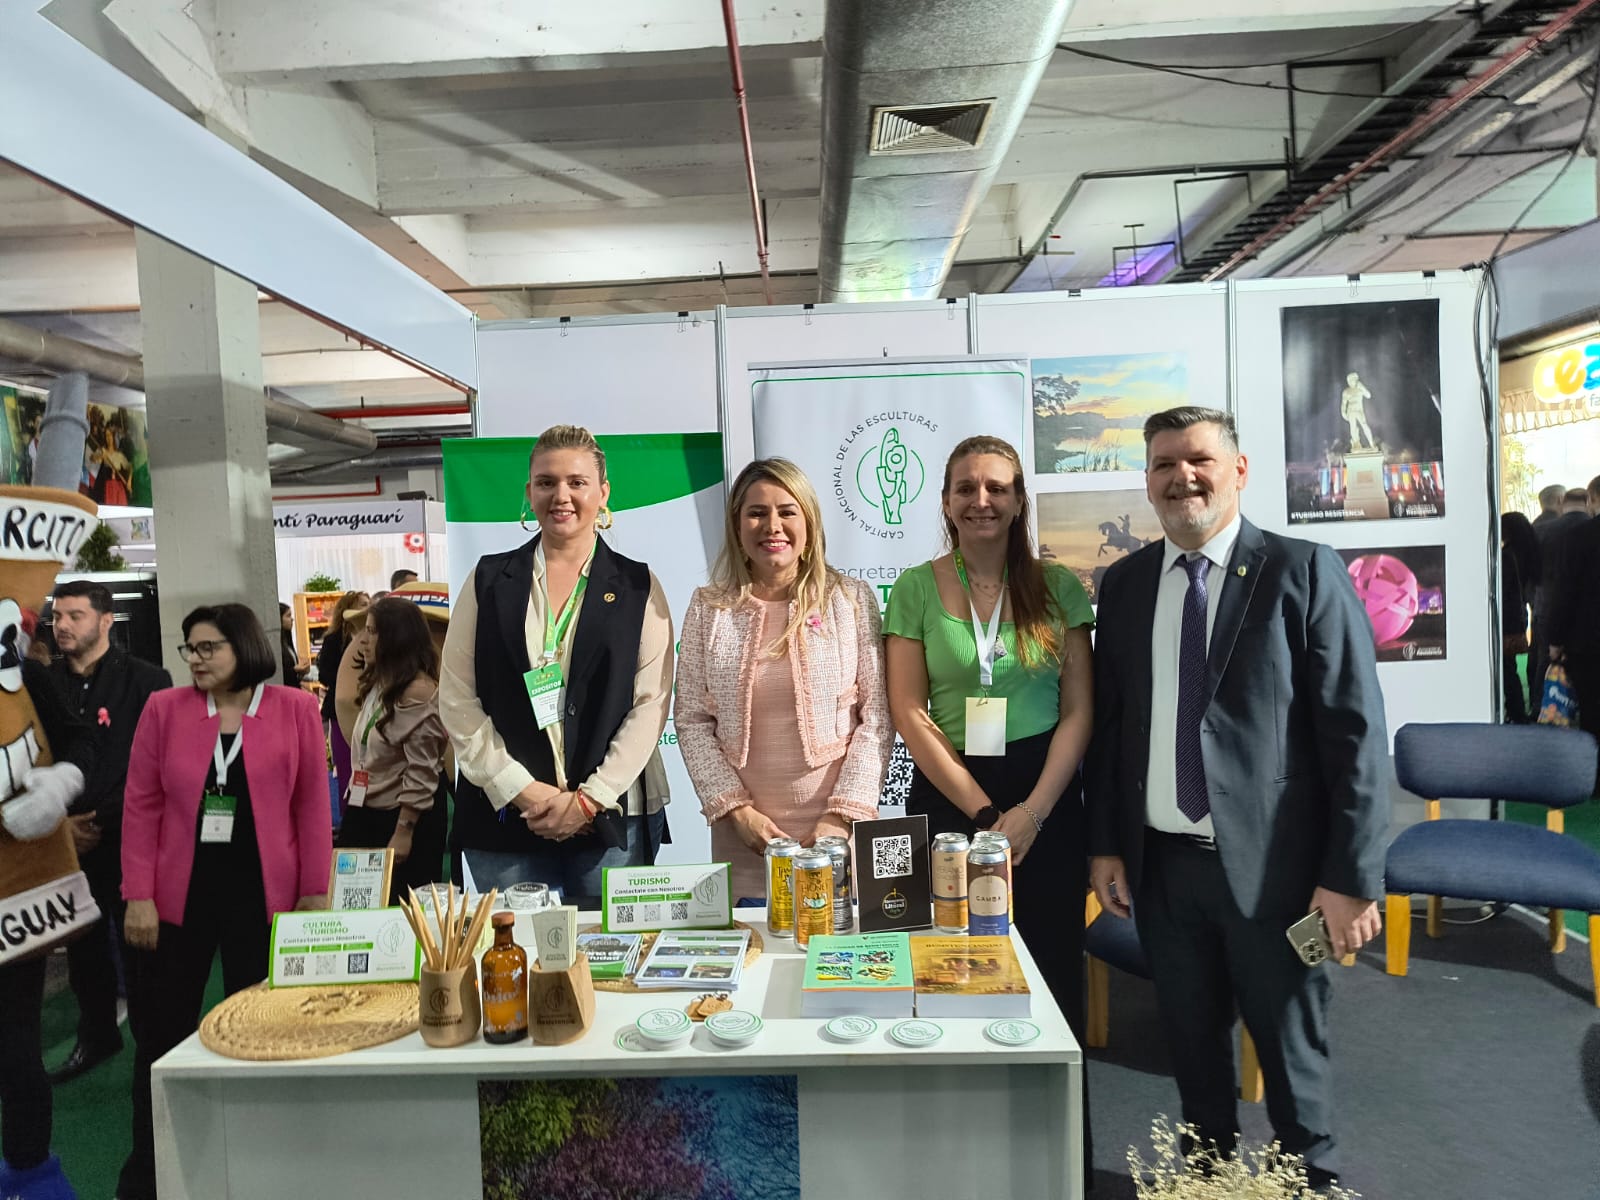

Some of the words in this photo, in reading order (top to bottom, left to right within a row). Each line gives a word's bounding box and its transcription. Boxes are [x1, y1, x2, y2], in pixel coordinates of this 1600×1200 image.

[865, 411, 938, 432] ESCULTURAS
[845, 424, 864, 444] LAS
[836, 445, 849, 460] DE
[833, 465, 857, 521] NACIONAL
[0, 505, 86, 556] RCITO
[859, 520, 904, 539] CAPITAL
[628, 877, 671, 886] TURISMO
[0, 891, 76, 951] GUAY
[302, 920, 342, 930] CULTURA
[309, 927, 349, 936] TURISMO
